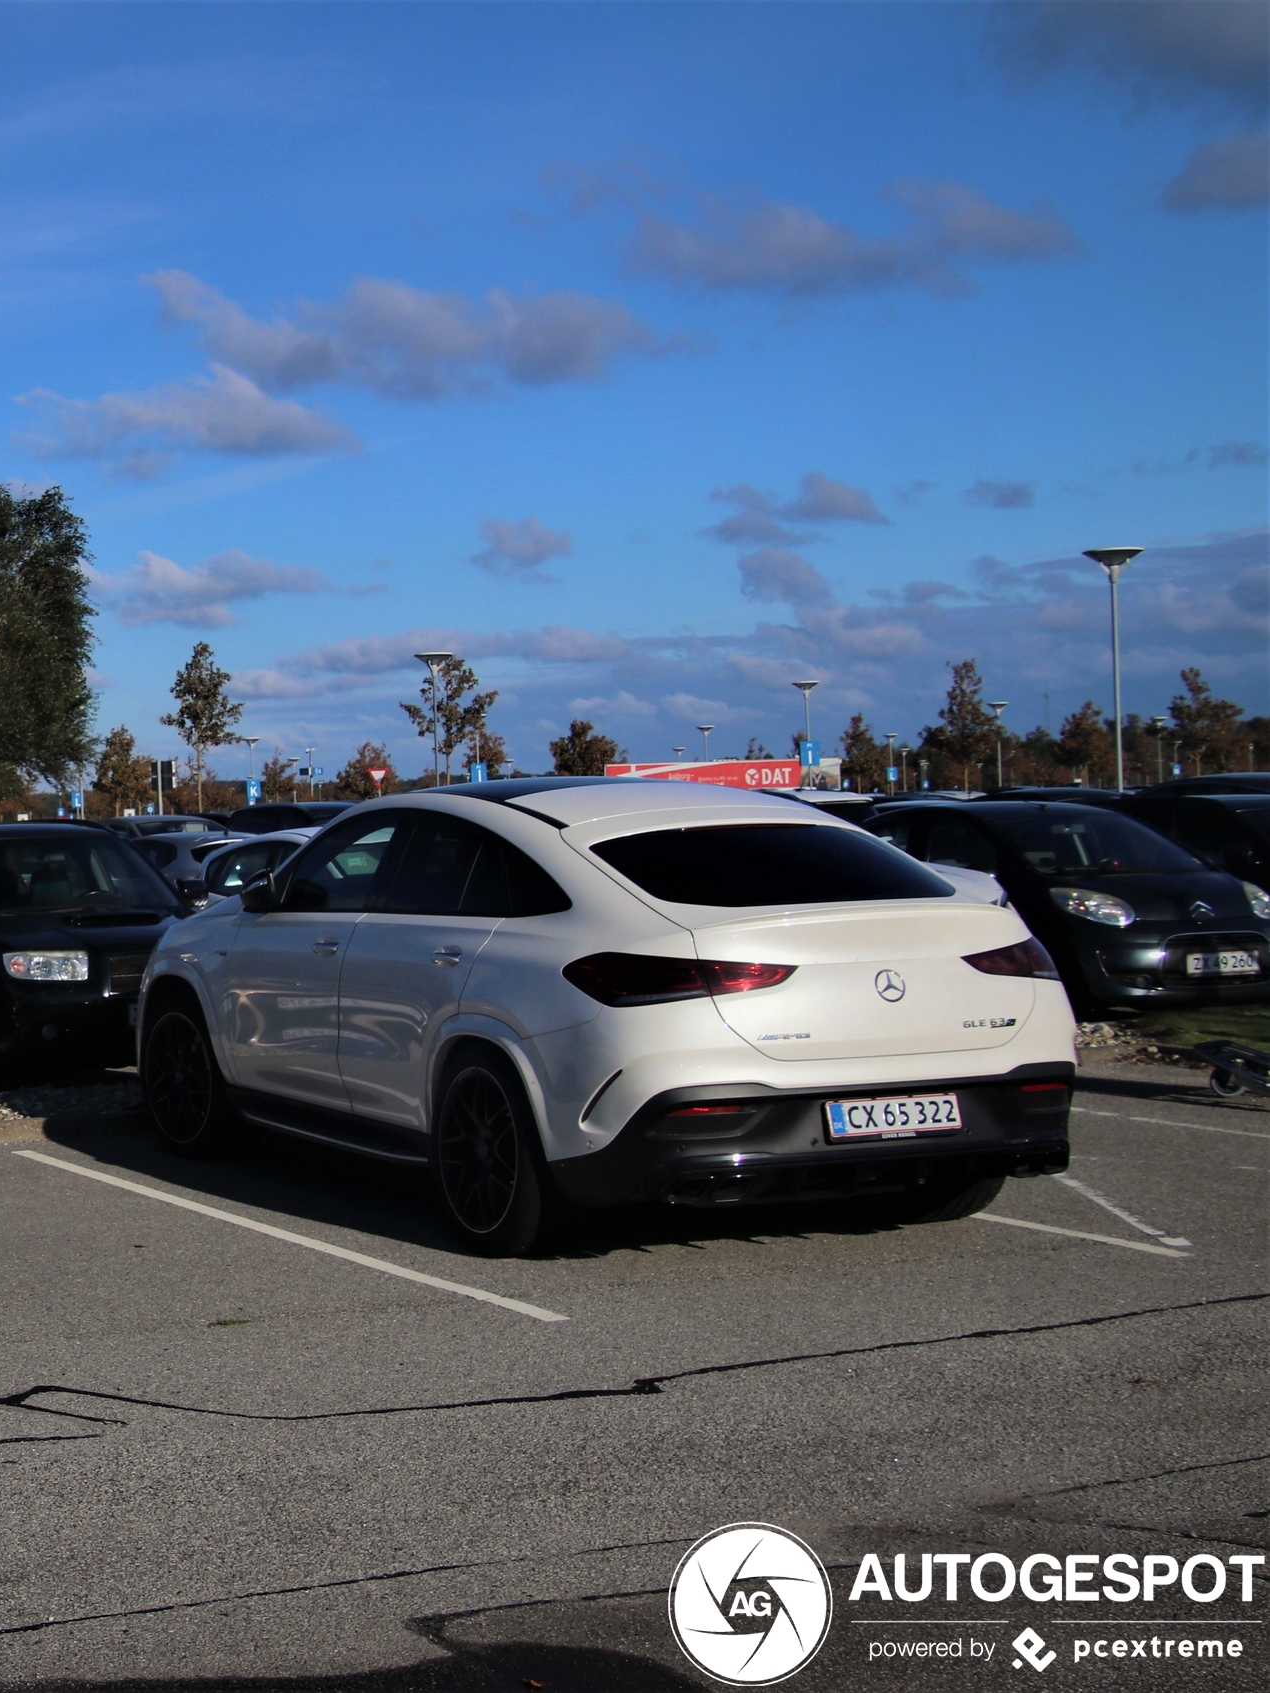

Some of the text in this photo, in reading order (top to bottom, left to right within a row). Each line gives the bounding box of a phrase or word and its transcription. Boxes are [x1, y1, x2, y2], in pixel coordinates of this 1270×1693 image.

[761, 768, 792, 784] DAT
[250, 786, 258, 797] K
[76, 797, 81, 806] L
[1213, 956, 1228, 969] 49
[1231, 955, 1254, 968] 260
[963, 1019, 987, 1028] GLE
[847, 1100, 957, 1129] CX 65 322
